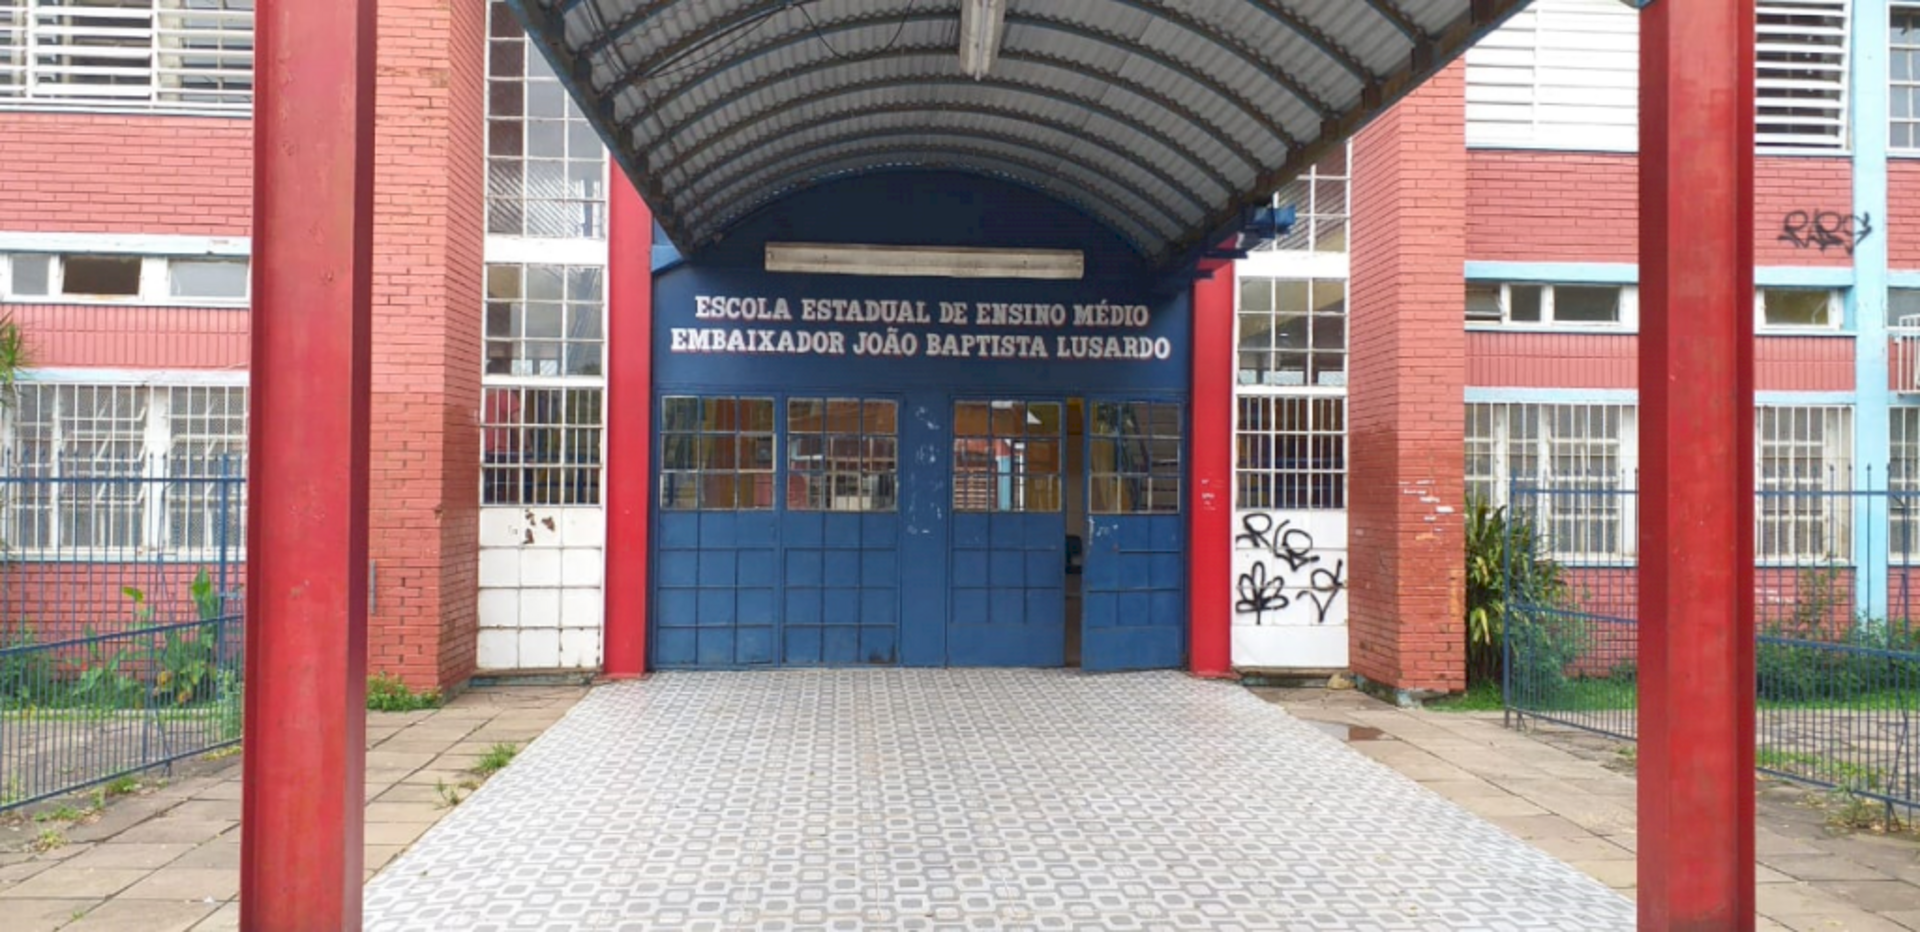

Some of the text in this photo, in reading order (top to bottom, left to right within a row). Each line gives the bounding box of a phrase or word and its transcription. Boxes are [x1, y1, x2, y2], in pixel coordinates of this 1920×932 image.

[695, 296, 1149, 327] ESCOLA ESTADUAL DE ENSINO MÉDIO
[670, 328, 1171, 360] EMBAIXADOR JOÃO BAPTISTA LUSARDO
